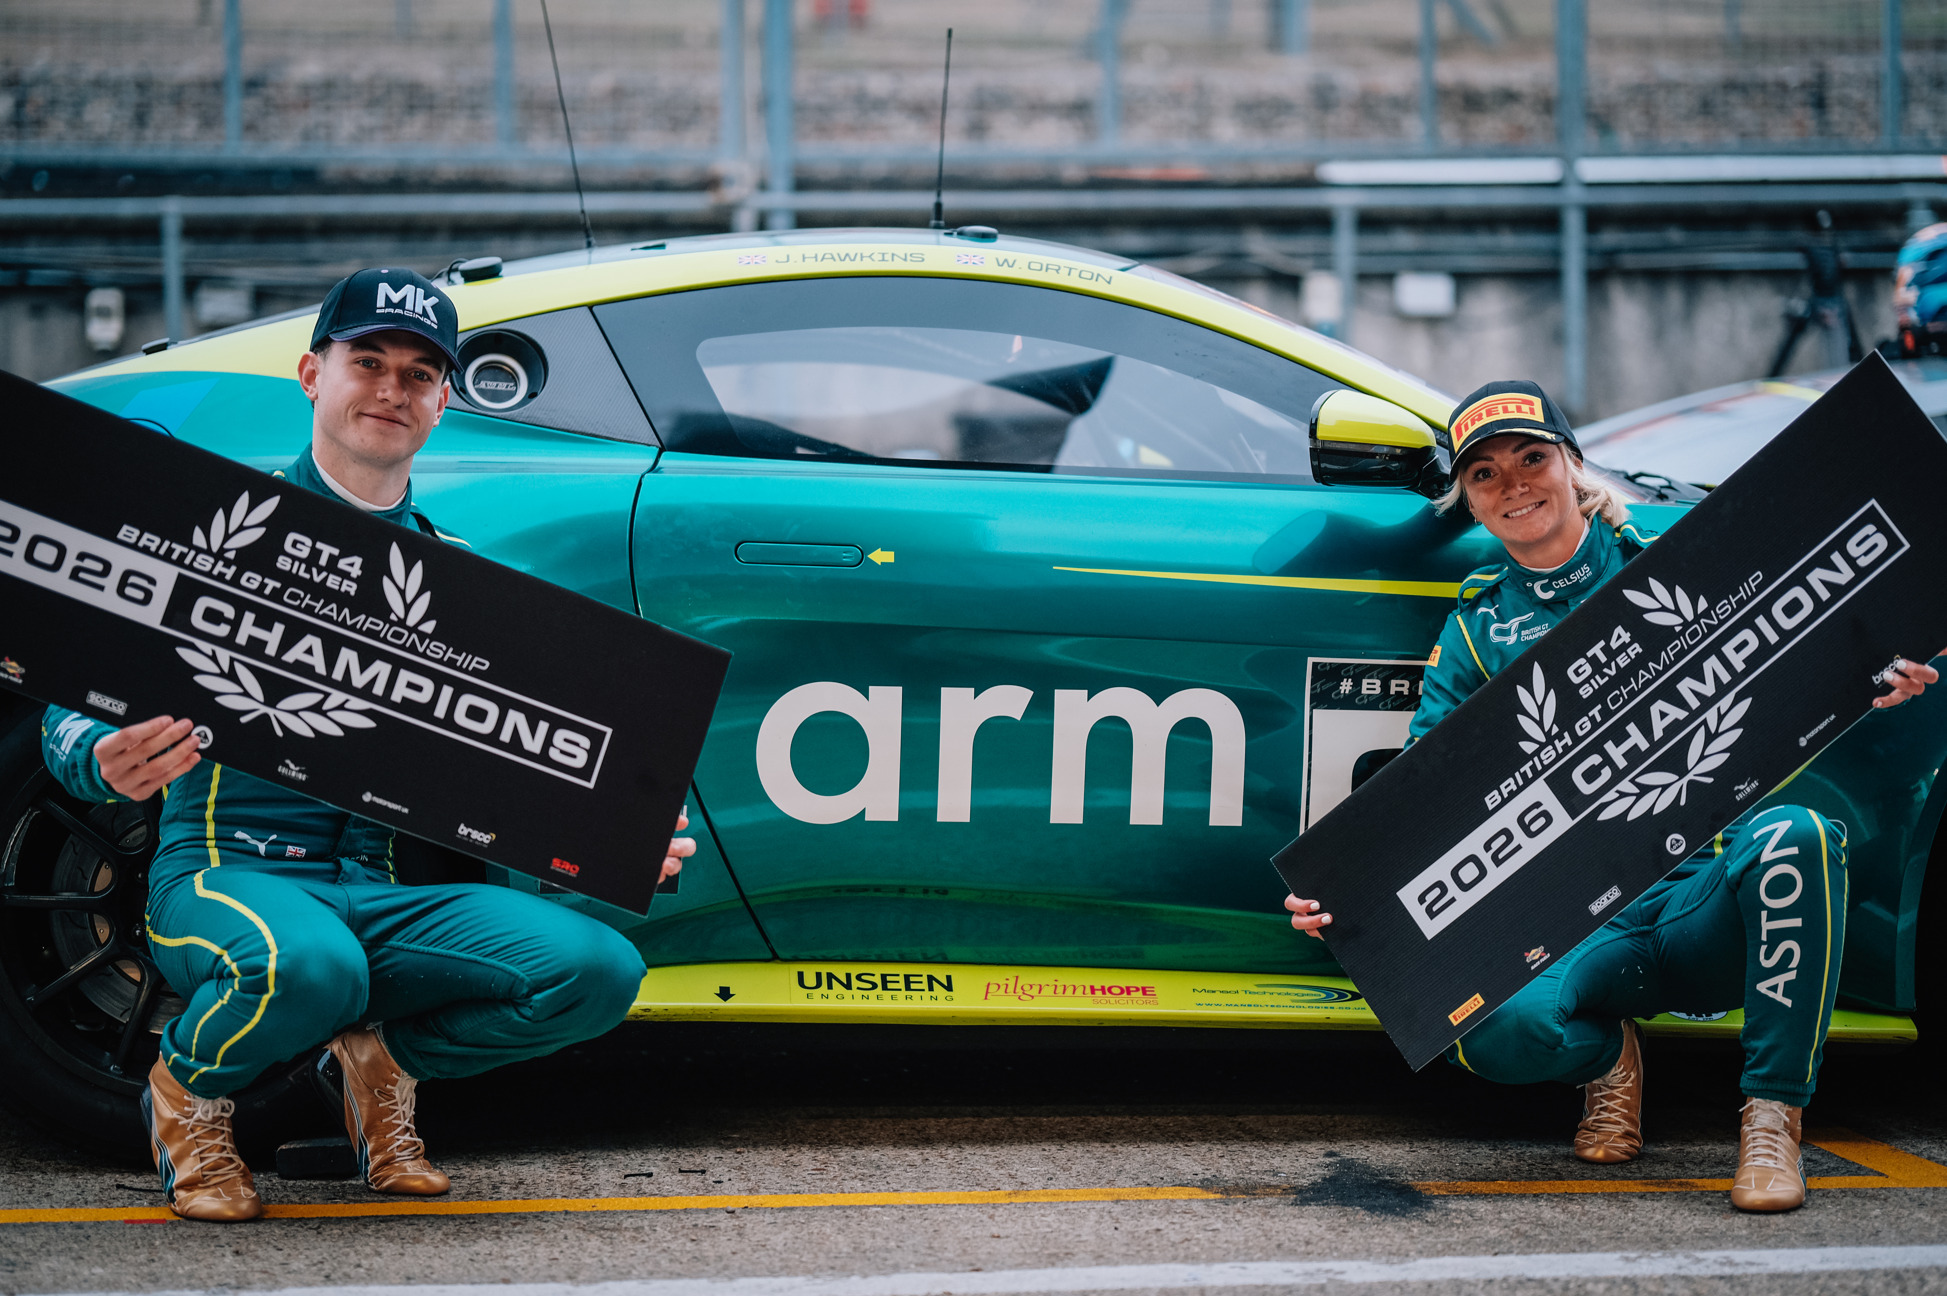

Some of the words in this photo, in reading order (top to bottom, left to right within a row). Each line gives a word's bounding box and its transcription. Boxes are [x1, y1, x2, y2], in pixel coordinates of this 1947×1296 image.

[376, 282, 439, 324] MK
[1455, 398, 1536, 442] PIRELLI
[284, 533, 362, 578] GT4
[276, 555, 357, 595] SILVER
[1552, 563, 1590, 589] CELSIUS
[116, 524, 236, 581] BRITISH
[240, 572, 281, 595] GT
[284, 587, 490, 671] CHAMPIONSHIP
[1521, 625, 1542, 636] BRITISH
[1541, 623, 1549, 631] GT
[1567, 624, 1631, 685] GT4
[1579, 643, 1643, 699] SILVER
[190, 597, 591, 769] CHAMPIONS
[1484, 730, 1573, 811] BRITISH
[1574, 704, 1602, 737] GT
[1606, 570, 1763, 710] CHAMPIONSHIP
[1418, 800, 1554, 921] 2026
[1571, 524, 1888, 795] CHAMPIONS
[1805, 718, 1831, 741] motorsport
[756, 682, 1246, 827] arm
[1735, 779, 1759, 801] GULLWING
[457, 822, 492, 845] brscc
[552, 857, 580, 875] SRO
[1590, 887, 1620, 914] sparco
[1755, 819, 1803, 1008] ASTON
[797, 970, 954, 992] UNSEEN
[806, 993, 954, 1001] ENGINEERING
[1241, 989, 1322, 998] Technologies
[1092, 998, 1159, 1006] SOLICITORS
[1452, 997, 1480, 1022] PIRELLI
